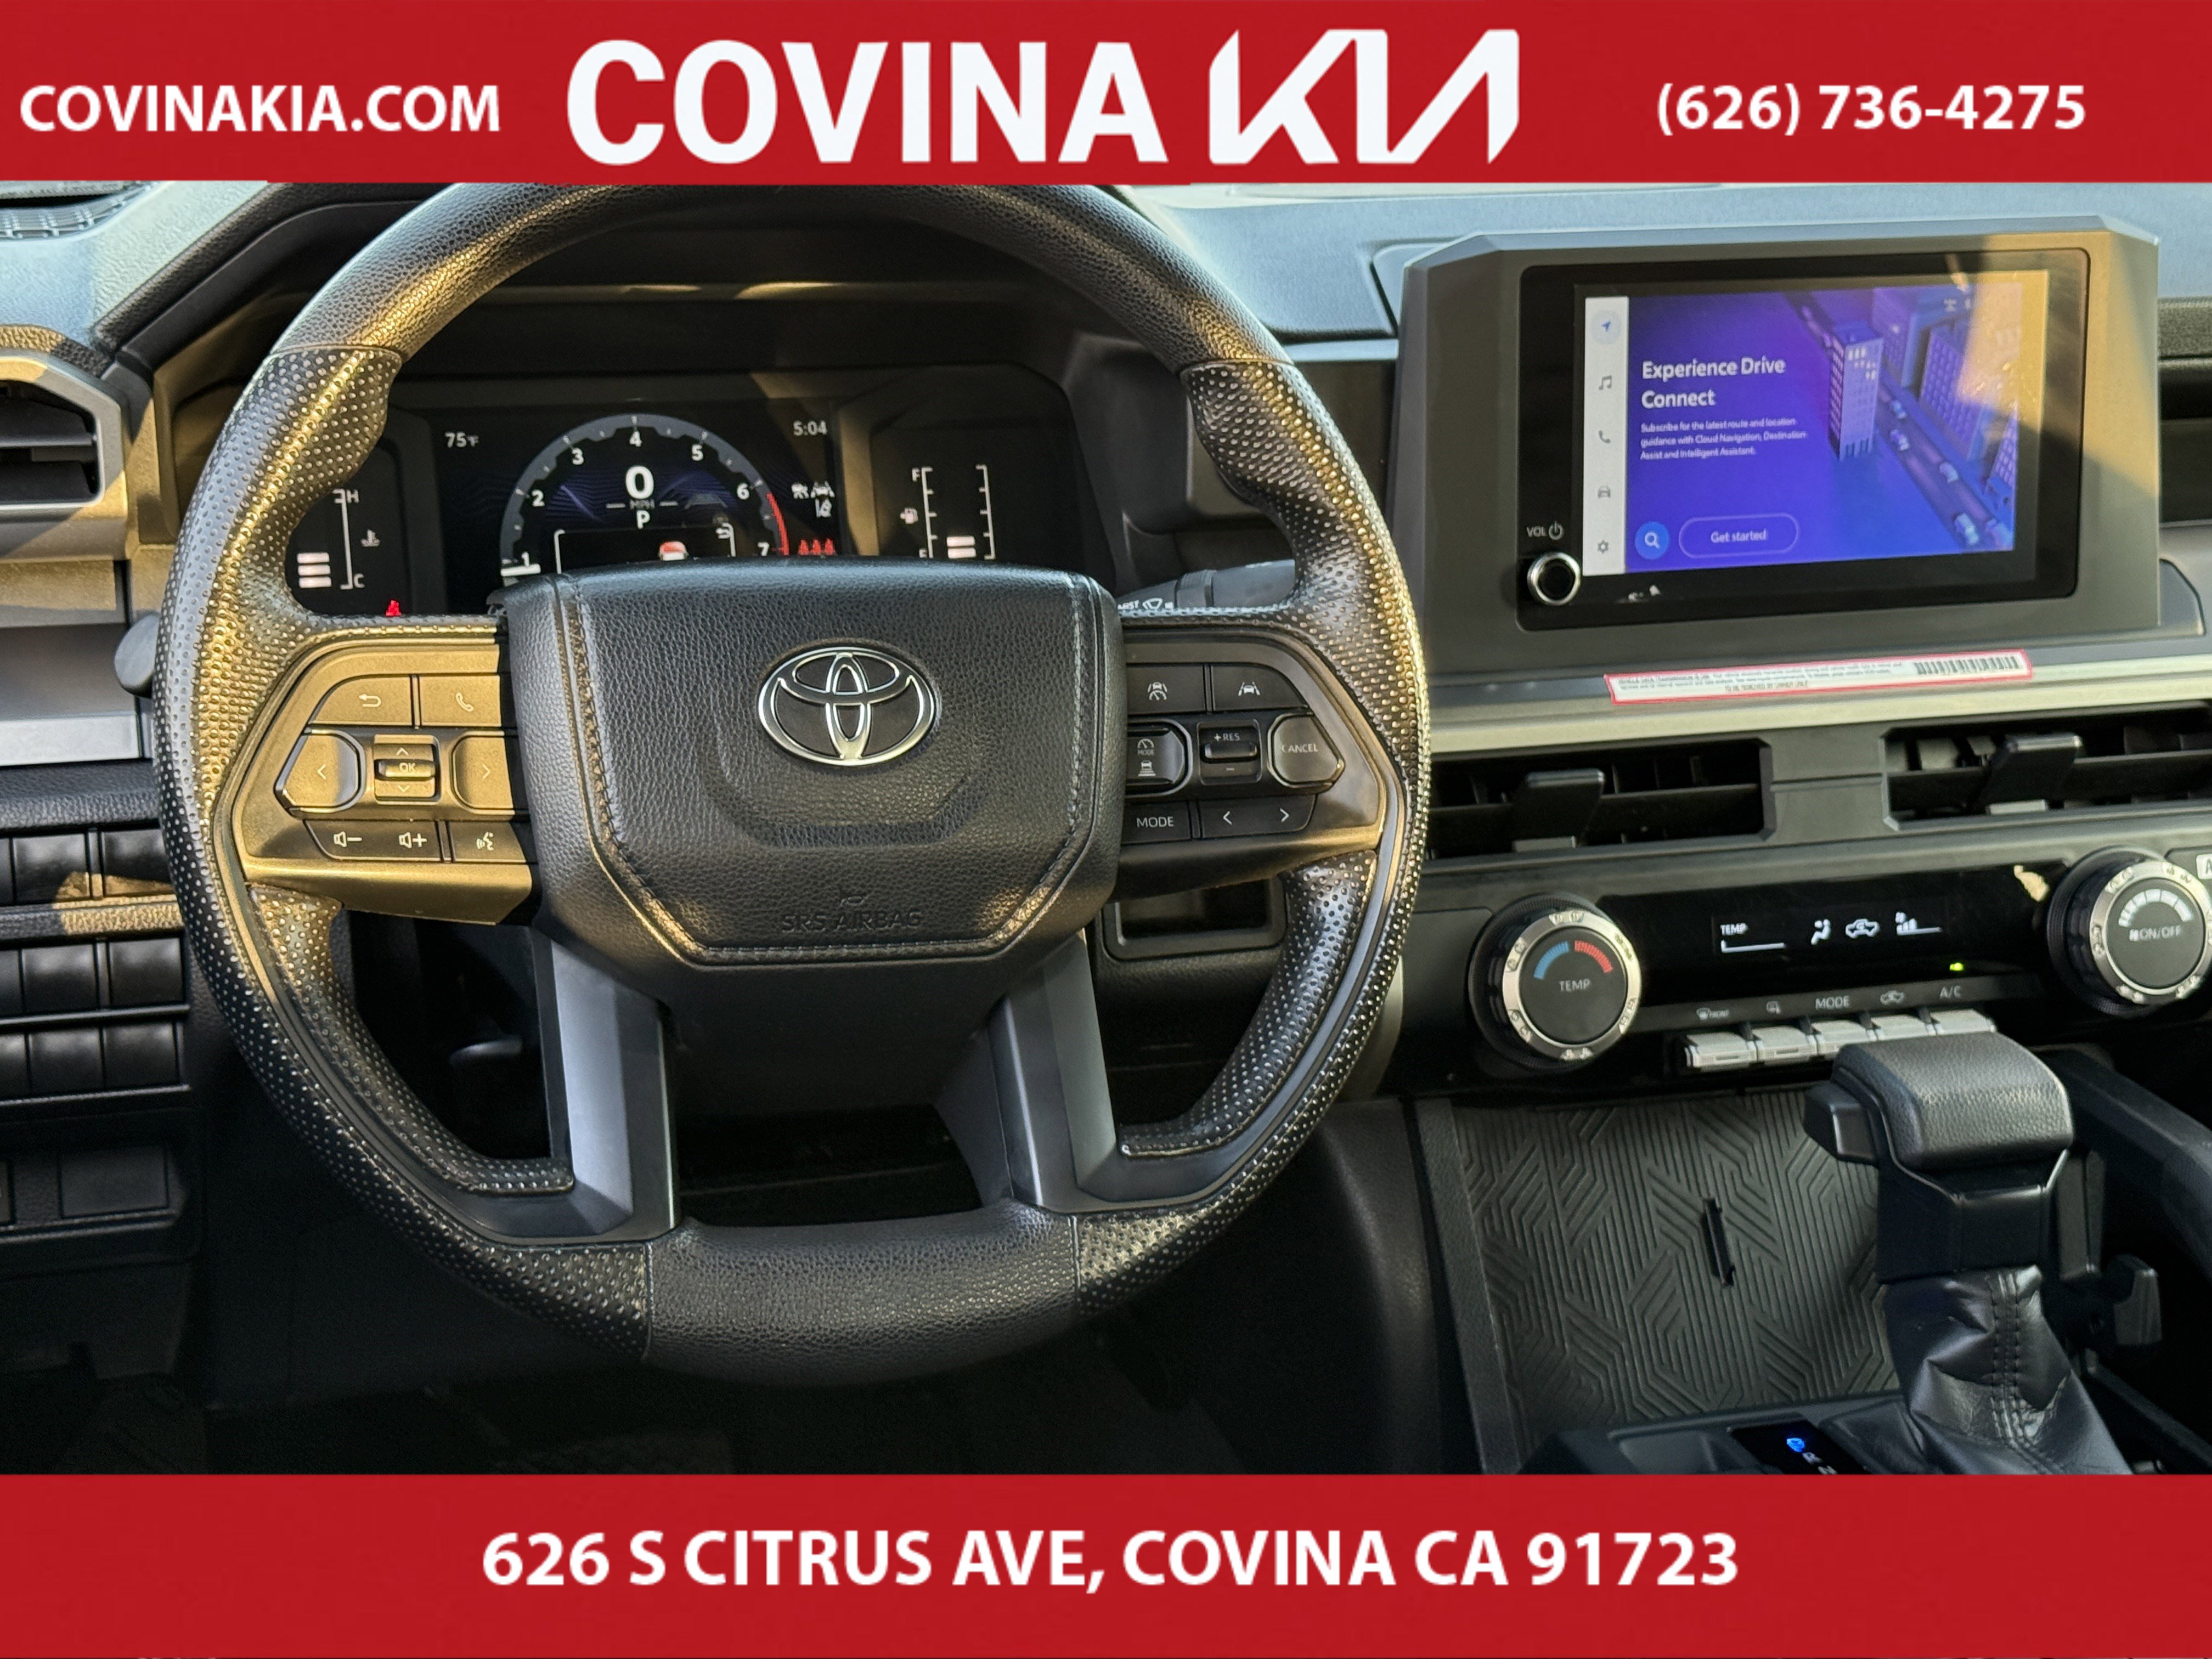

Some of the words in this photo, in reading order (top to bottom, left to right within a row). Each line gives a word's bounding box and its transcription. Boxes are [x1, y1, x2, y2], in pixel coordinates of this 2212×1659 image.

[1642, 358, 1737, 382] Experience
[1741, 356, 1786, 375] Drive
[1641, 389, 1716, 408] Connect
[793, 421, 827, 436] 5:04
[1641, 422, 1678, 433] Subscribe
[1680, 421, 1690, 431] for
[1692, 421, 1704, 430] the
[1706, 420, 1727, 429] latest
[1728, 420, 1748, 428] route
[1750, 418, 1764, 427] and
[629, 432, 642, 447] 4
[1641, 436, 1676, 448] guidance
[1678, 435, 1694, 444] with
[1695, 433, 1718, 444] Cloud
[571, 449, 584, 465] 3
[692, 445, 703, 461] 5
[1640, 450, 1662, 460] Assist
[1664, 450, 1679, 458] and
[1680, 448, 1718, 459] Intelligent
[912, 469, 921, 481] F
[625, 466, 654, 499] 0
[347, 490, 359, 503] H
[532, 490, 545, 507] 2
[736, 484, 749, 499] 6
[636, 511, 650, 528] P
[1526, 526, 1546, 538] VOL
[1710, 531, 1729, 543] Get
[1732, 529, 1767, 542] started
[758, 543, 769, 556] 7
[354, 574, 364, 588] C
[1282, 744, 1318, 753] CANCEL
[399, 763, 415, 774] OK
[1137, 816, 1174, 827] MODE
[782, 915, 826, 933] SRS
[834, 910, 923, 931] AIRBAG
[1720, 923, 1748, 935] TEMP
[2140, 926, 2182, 940] ON/OFF
[1559, 979, 1591, 992] TEMP
[1940, 986, 1963, 999] A/C
[1815, 995, 1850, 1010] MODE
[1709, 1009, 1729, 1019] FRONT
